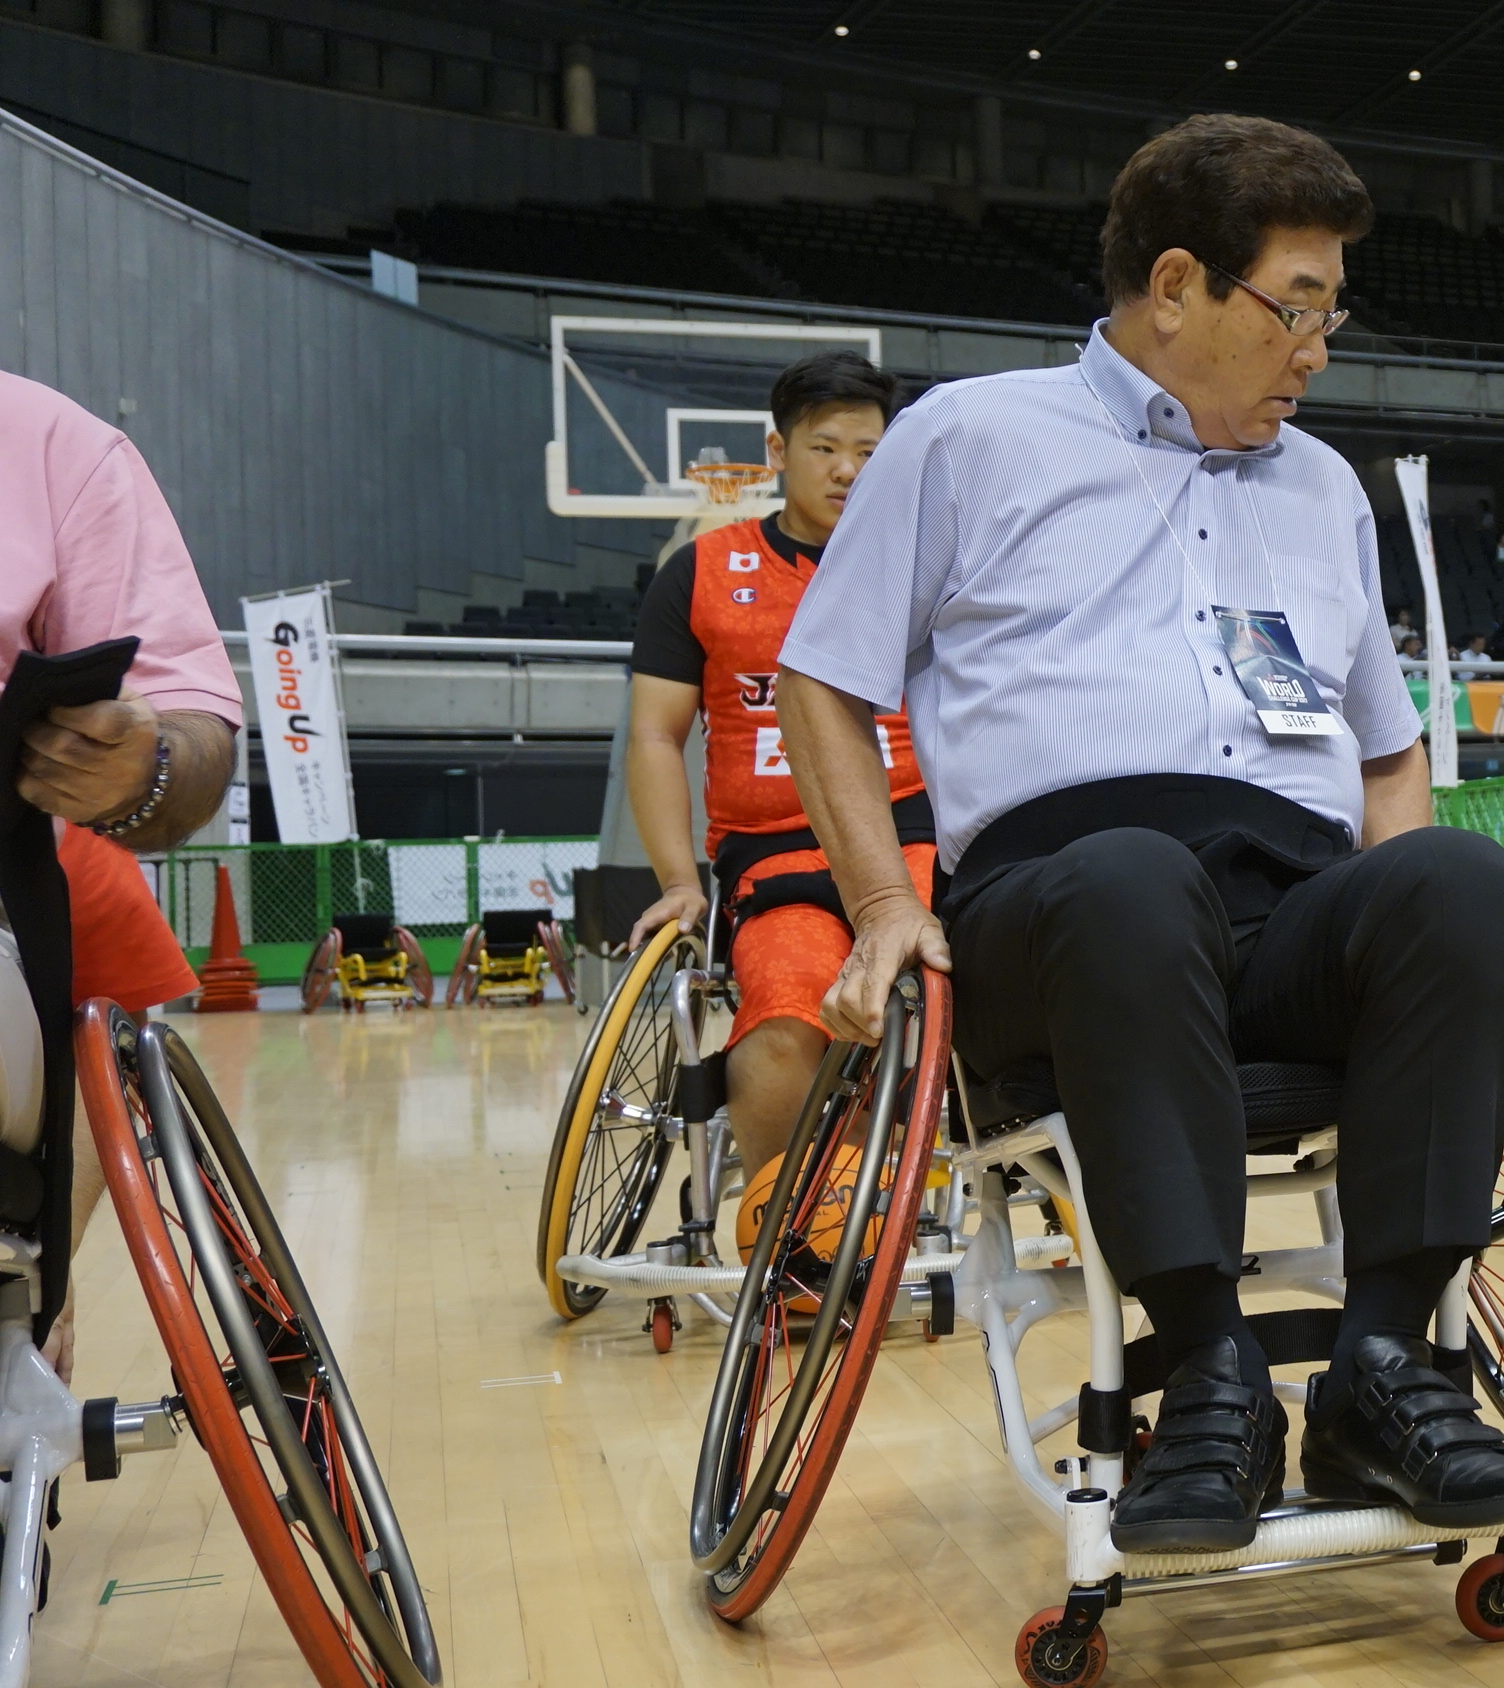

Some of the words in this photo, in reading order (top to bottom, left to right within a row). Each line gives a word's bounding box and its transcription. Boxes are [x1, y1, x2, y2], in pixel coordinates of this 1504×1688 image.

[264, 621, 303, 710] Going
[284, 713, 324, 754] Up
[1257, 676, 1306, 698] WORLD
[1281, 713, 1318, 729] STAFF
